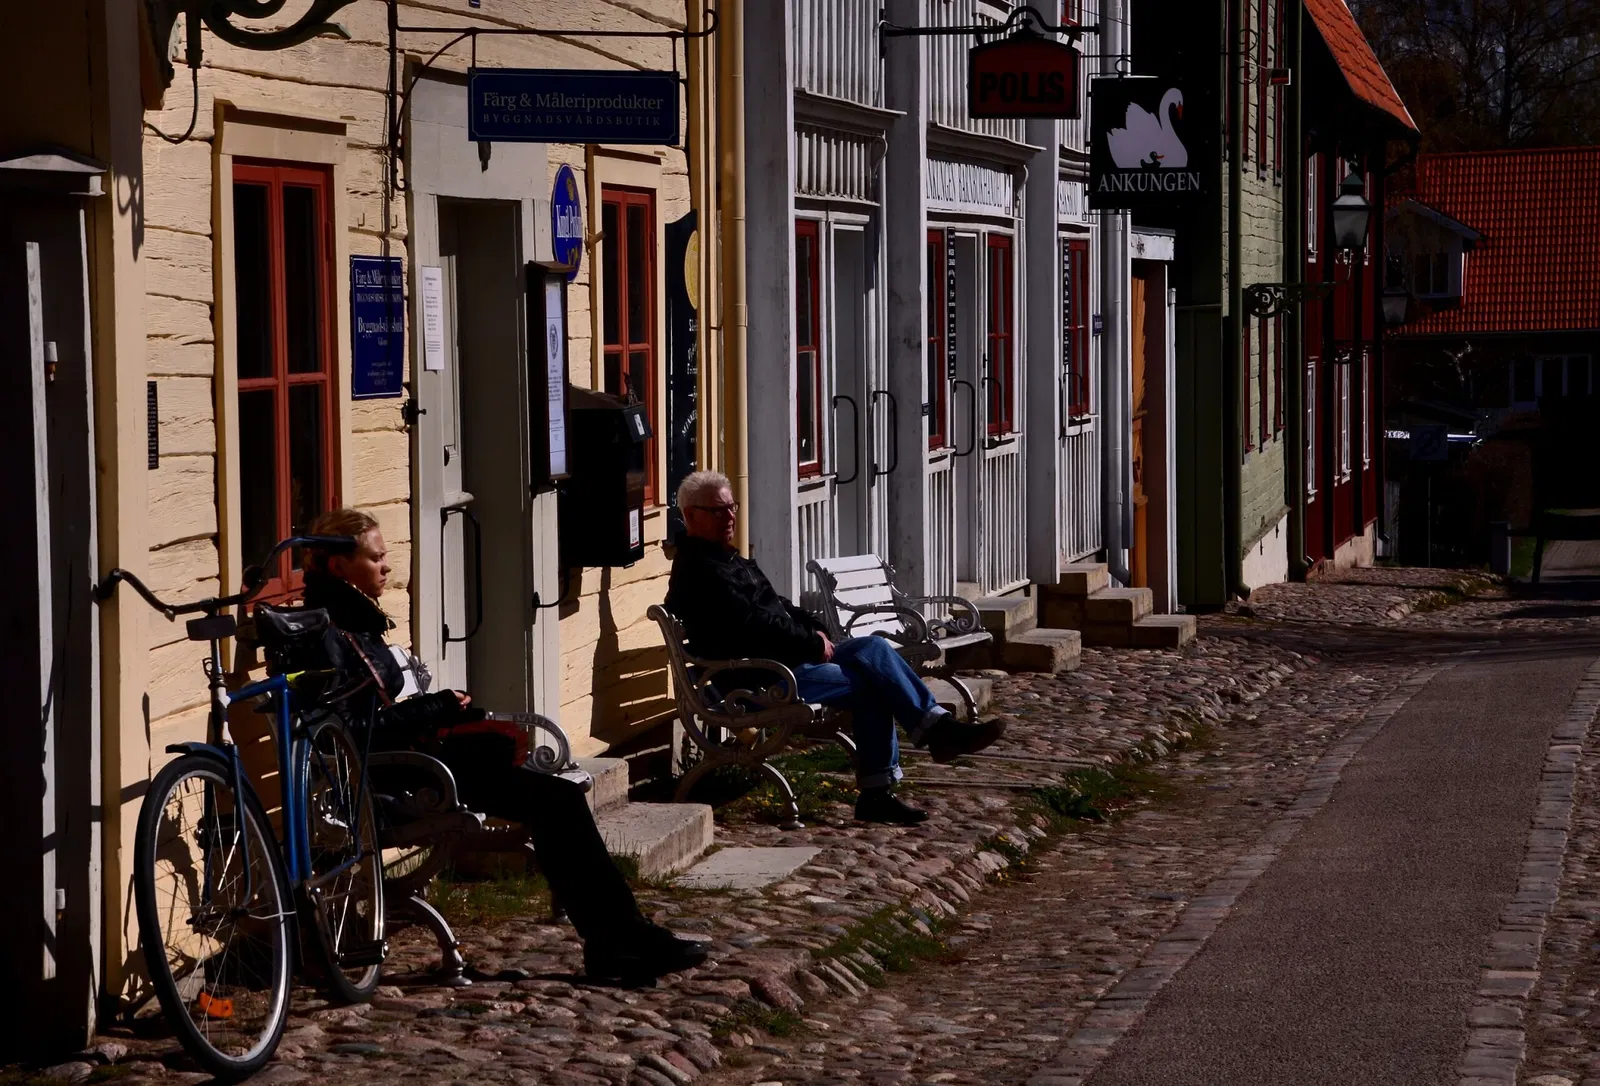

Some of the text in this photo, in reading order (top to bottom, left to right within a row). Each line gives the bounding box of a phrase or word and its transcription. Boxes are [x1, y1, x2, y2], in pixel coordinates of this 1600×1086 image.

[979, 71, 1065, 104] POLIS
[483, 92, 664, 111] Färg & Måleriprodukter
[1098, 171, 1201, 193] ANKUNGEN
